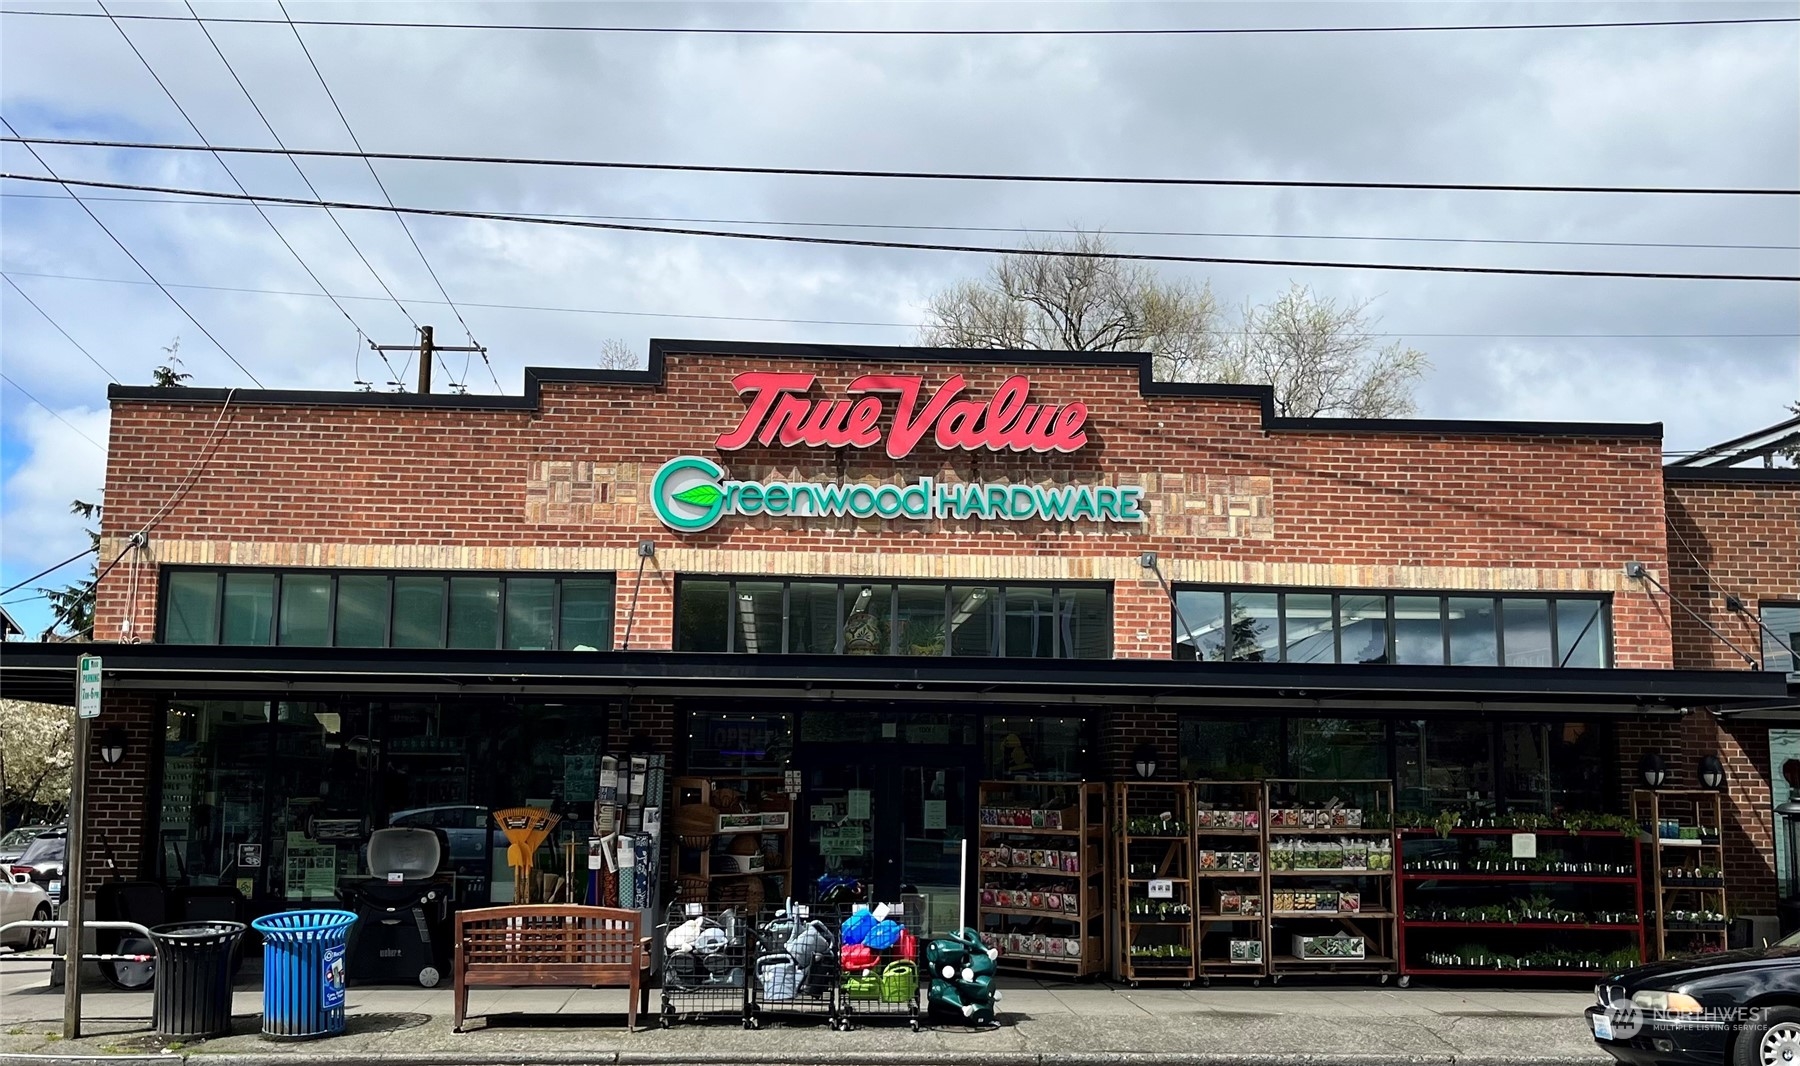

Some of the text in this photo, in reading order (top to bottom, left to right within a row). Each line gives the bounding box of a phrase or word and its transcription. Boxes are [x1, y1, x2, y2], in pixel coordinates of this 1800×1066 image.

[715, 372, 1089, 460] True Value
[652, 456, 1145, 533] Greenwood HARDWARE
[82, 673, 100, 683] PARKING
